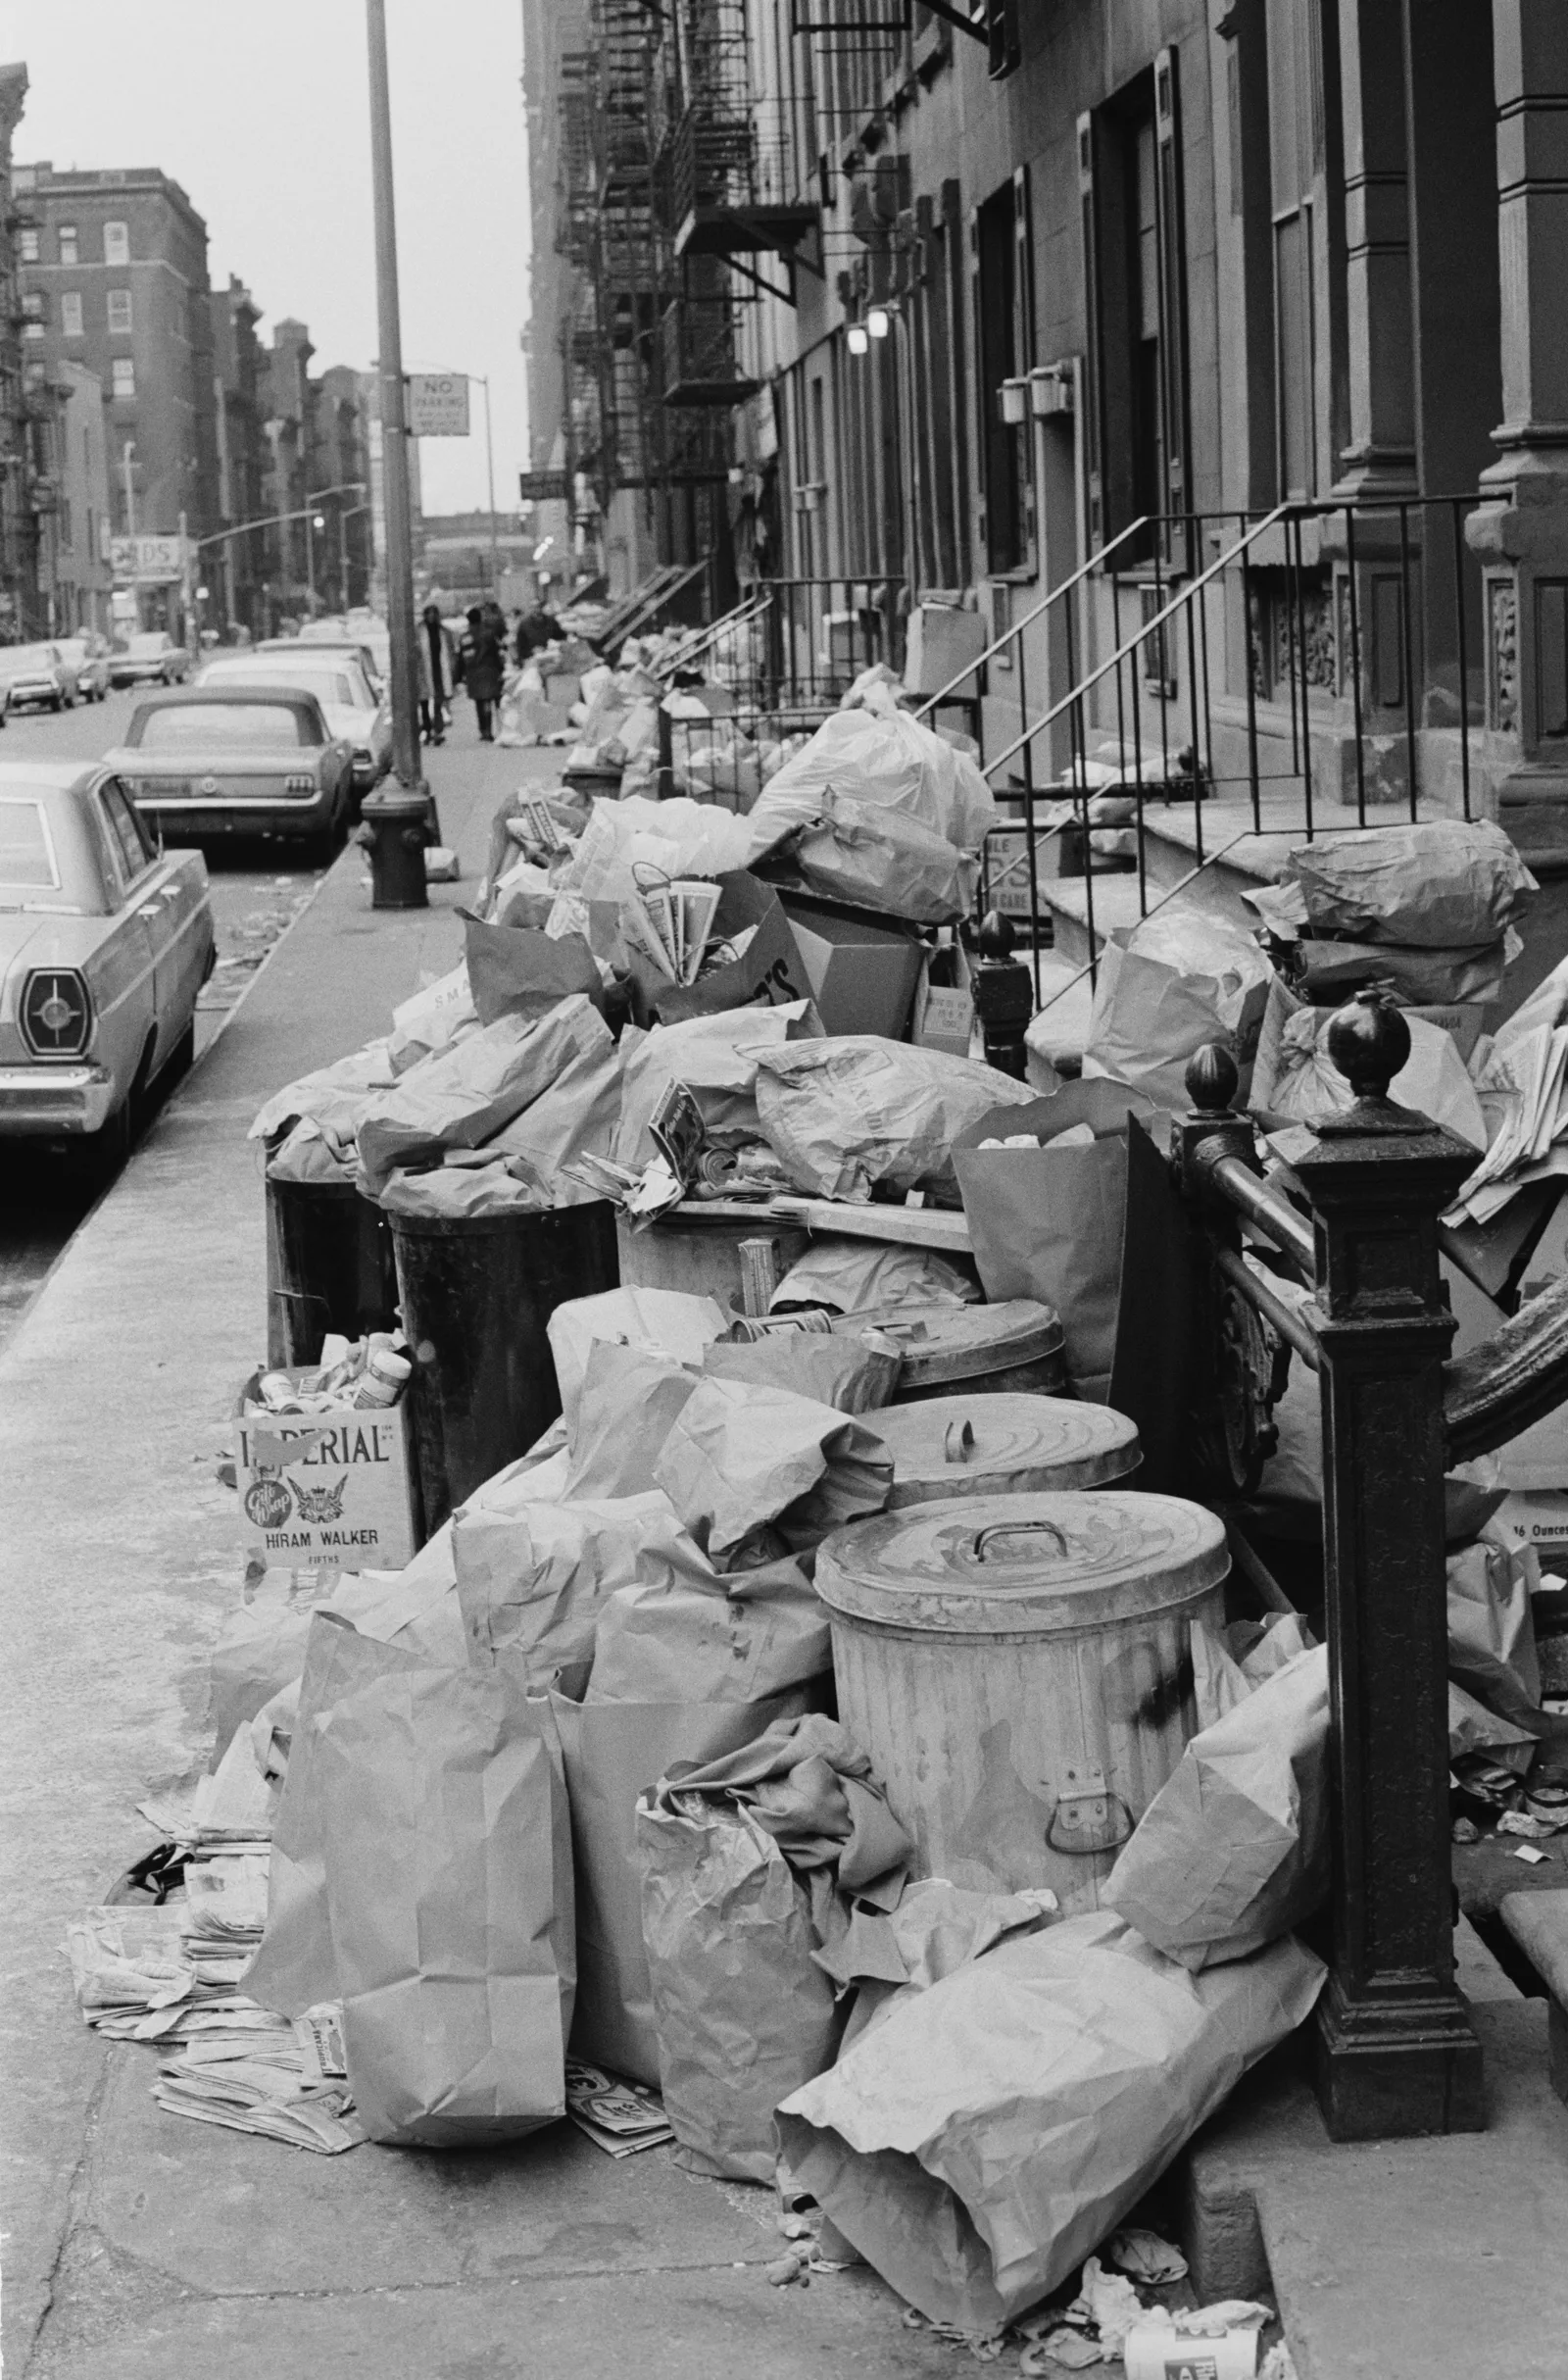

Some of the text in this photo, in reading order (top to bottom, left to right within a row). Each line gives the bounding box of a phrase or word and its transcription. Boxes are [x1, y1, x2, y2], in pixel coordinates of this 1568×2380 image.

[423, 379, 454, 394] NO
[239, 1425, 390, 1467] IERIAL
[248, 1483, 275, 1511] Gift
[251, 1494, 291, 1526] Wrap
[266, 1529, 379, 1549] HIRAM WALKER
[308, 1555, 340, 1564] FIFTHS
[313, 2029, 333, 2072] TROPICANA
